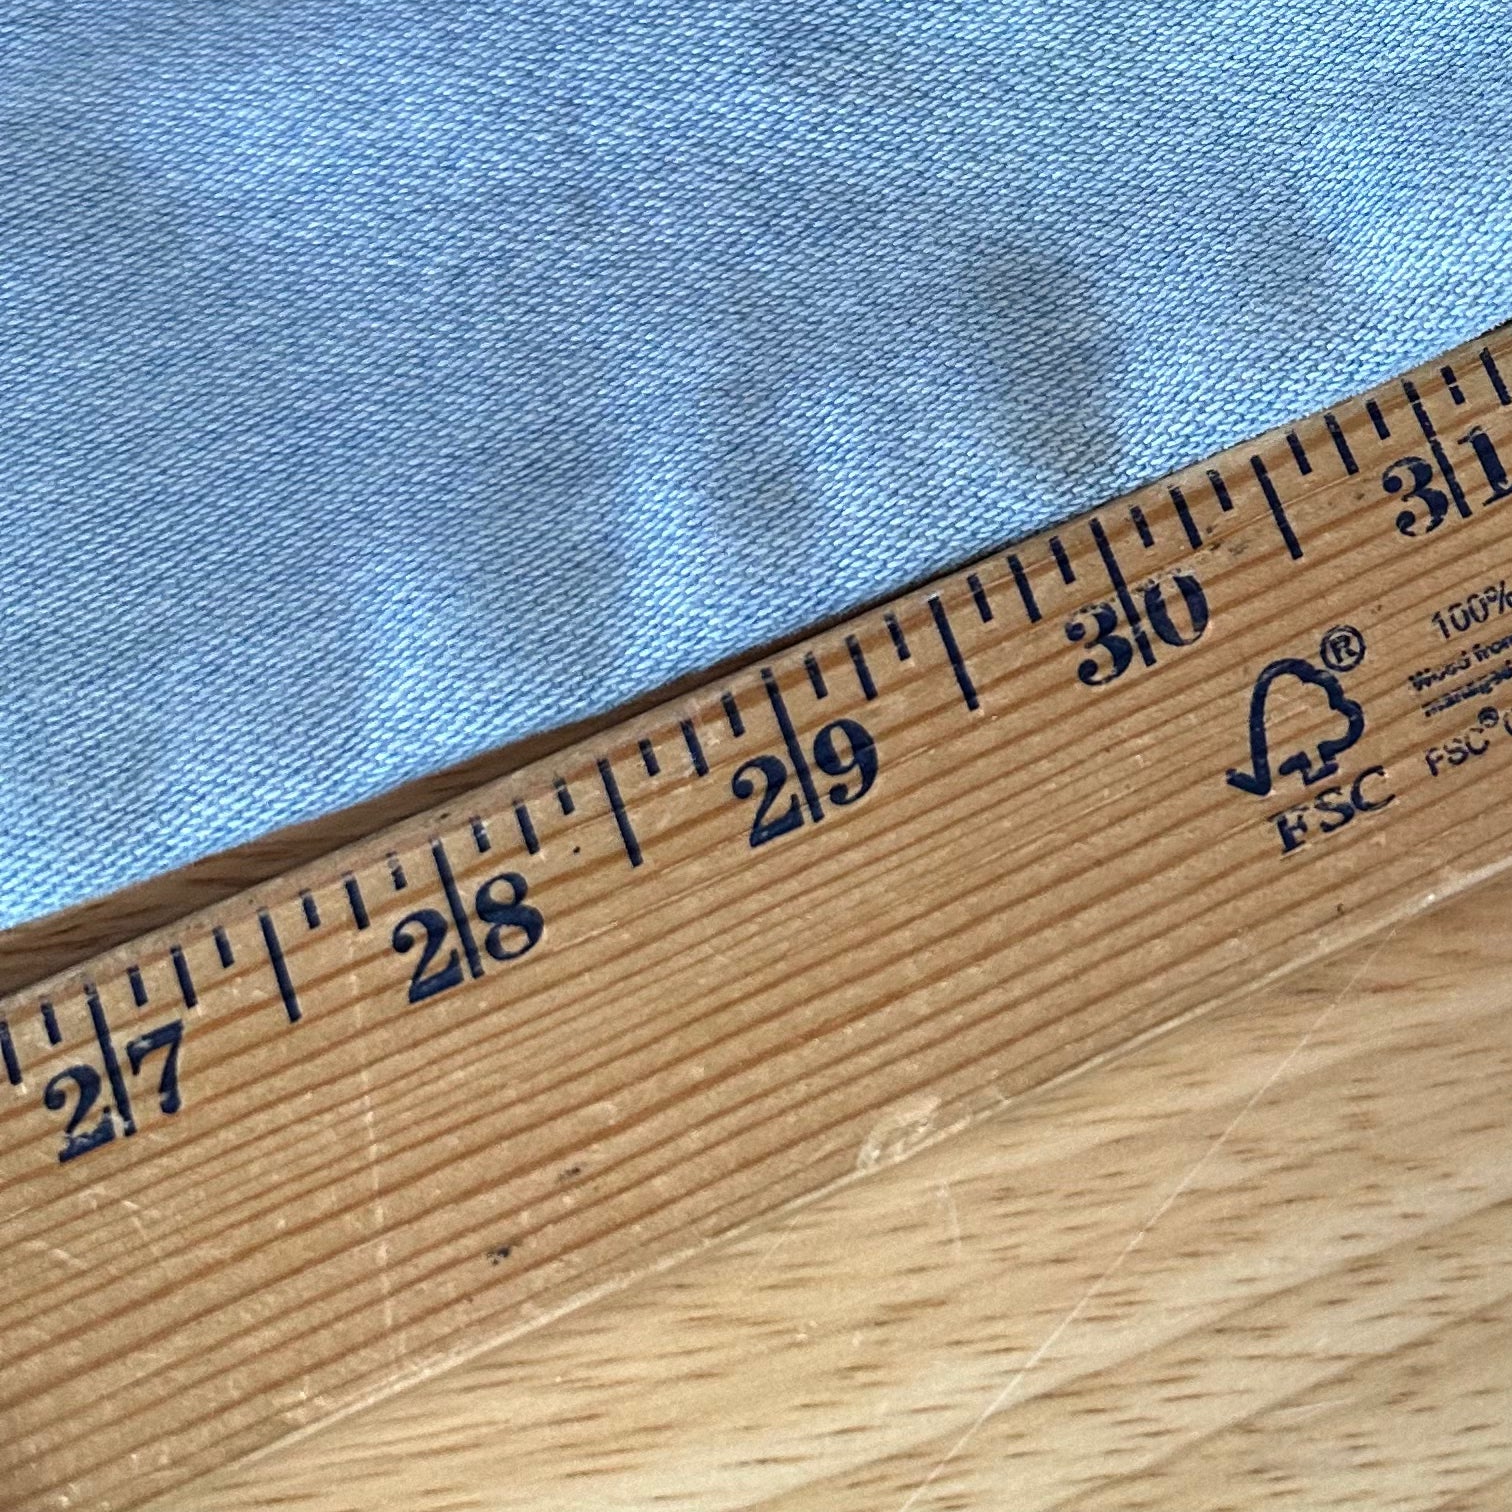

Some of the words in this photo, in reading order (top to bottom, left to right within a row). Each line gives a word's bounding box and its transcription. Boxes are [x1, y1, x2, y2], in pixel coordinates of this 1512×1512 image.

[1065, 569, 1209, 685] 30
[732, 719, 879, 848] 29
[1268, 765, 1396, 855] FSC
[392, 872, 545, 1003] 28
[44, 1019, 183, 1163] 27
